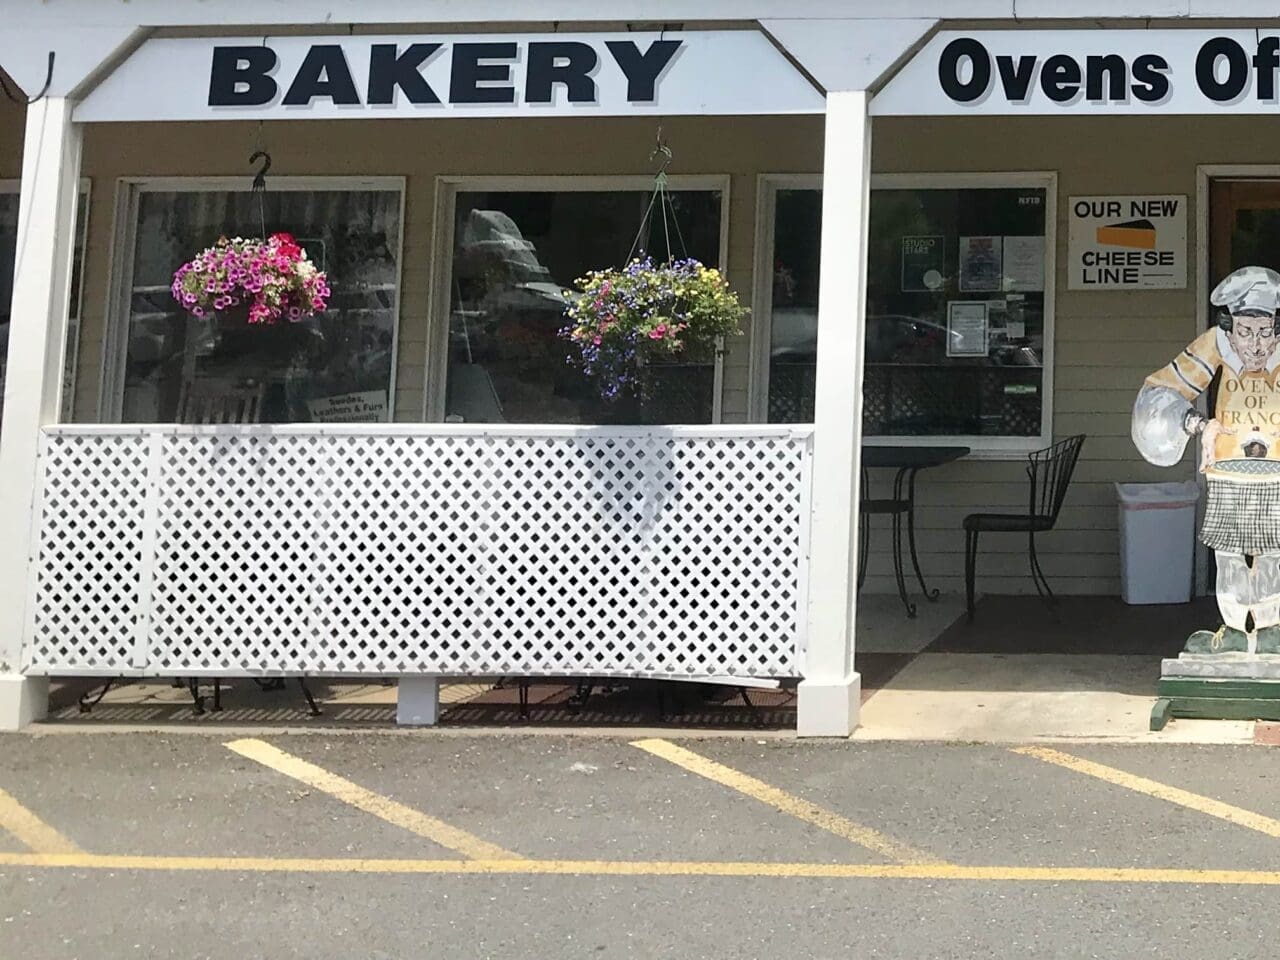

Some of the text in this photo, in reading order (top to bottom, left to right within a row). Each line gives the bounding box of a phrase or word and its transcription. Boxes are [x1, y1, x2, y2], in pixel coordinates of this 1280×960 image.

[208, 40, 684, 106] BAKERY
[938, 37, 1170, 102] Ovens
[1195, 36, 1280, 102] Of
[1074, 200, 1179, 218] OUR NEW
[904, 239, 935, 247] STUDIO
[1081, 251, 1175, 267] CHEESE
[1082, 268, 1139, 284] LINE
[313, 402, 383, 417] Leathers & Furs
[1244, 395, 1268, 409] OF
